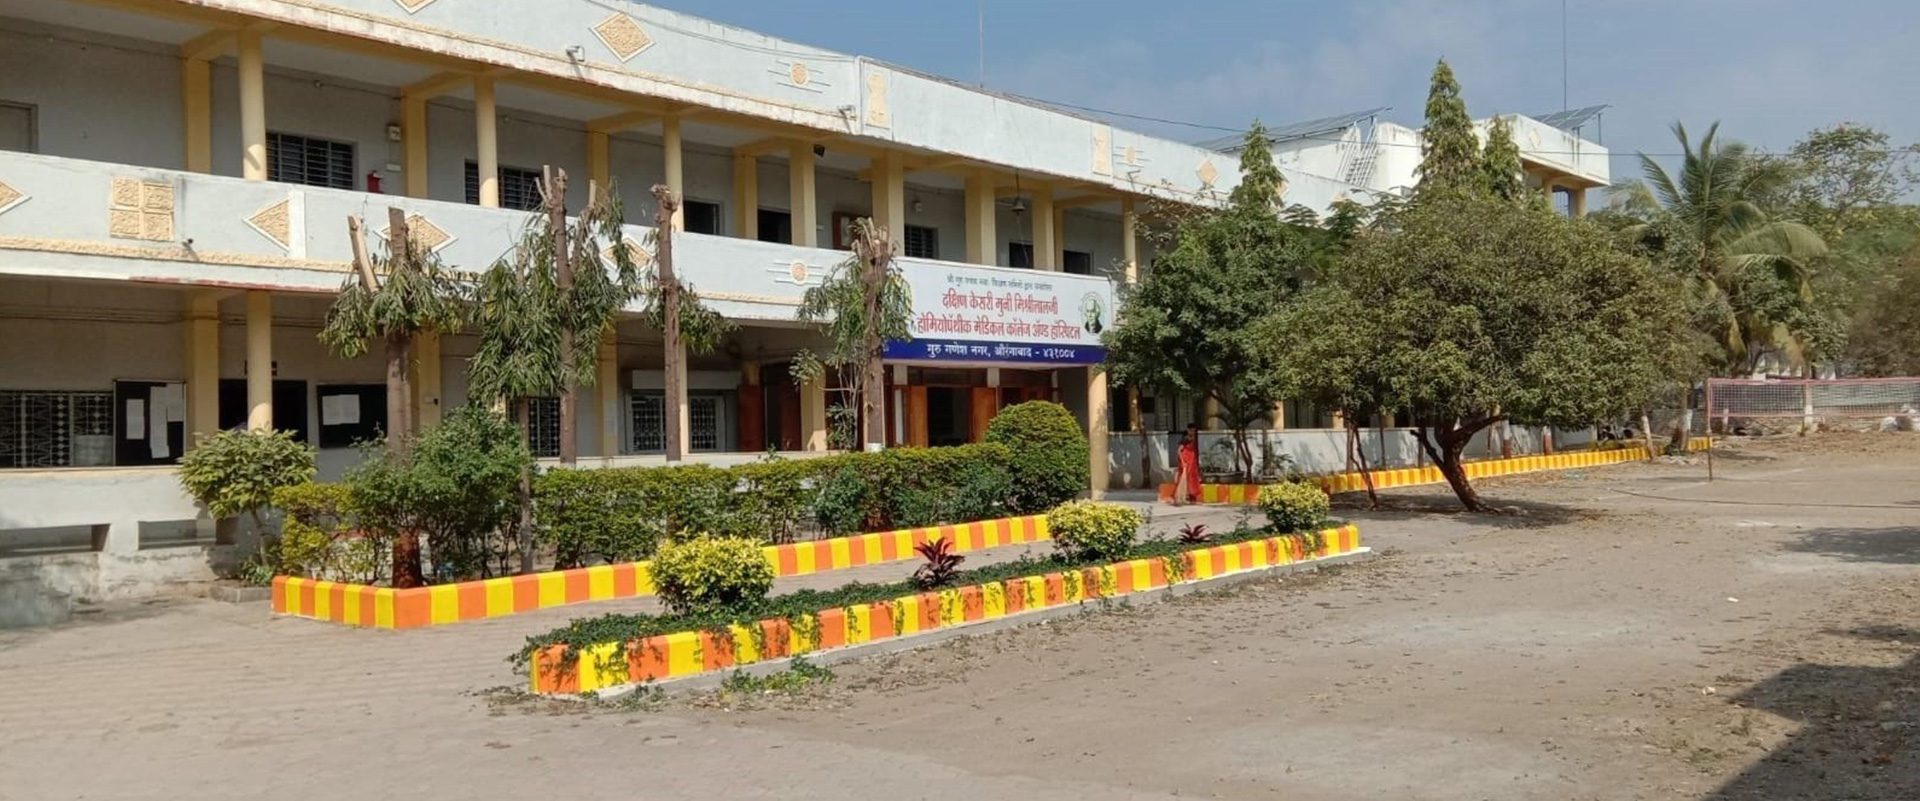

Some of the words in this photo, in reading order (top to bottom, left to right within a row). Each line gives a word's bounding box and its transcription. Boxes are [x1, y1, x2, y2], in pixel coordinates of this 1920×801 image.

[942, 287, 967, 309] दक्षिण
[969, 290, 993, 310] केसरी
[974, 314, 1004, 336] मेडिकल
[1006, 316, 1030, 337] कॉलेज
[926, 344, 941, 358] गुरु
[944, 341, 967, 355] गणेश
[970, 345, 991, 357] नगर,
[995, 343, 1032, 358] औरंगाबाद
[1043, 348, 1075, 359] ४३१००४
